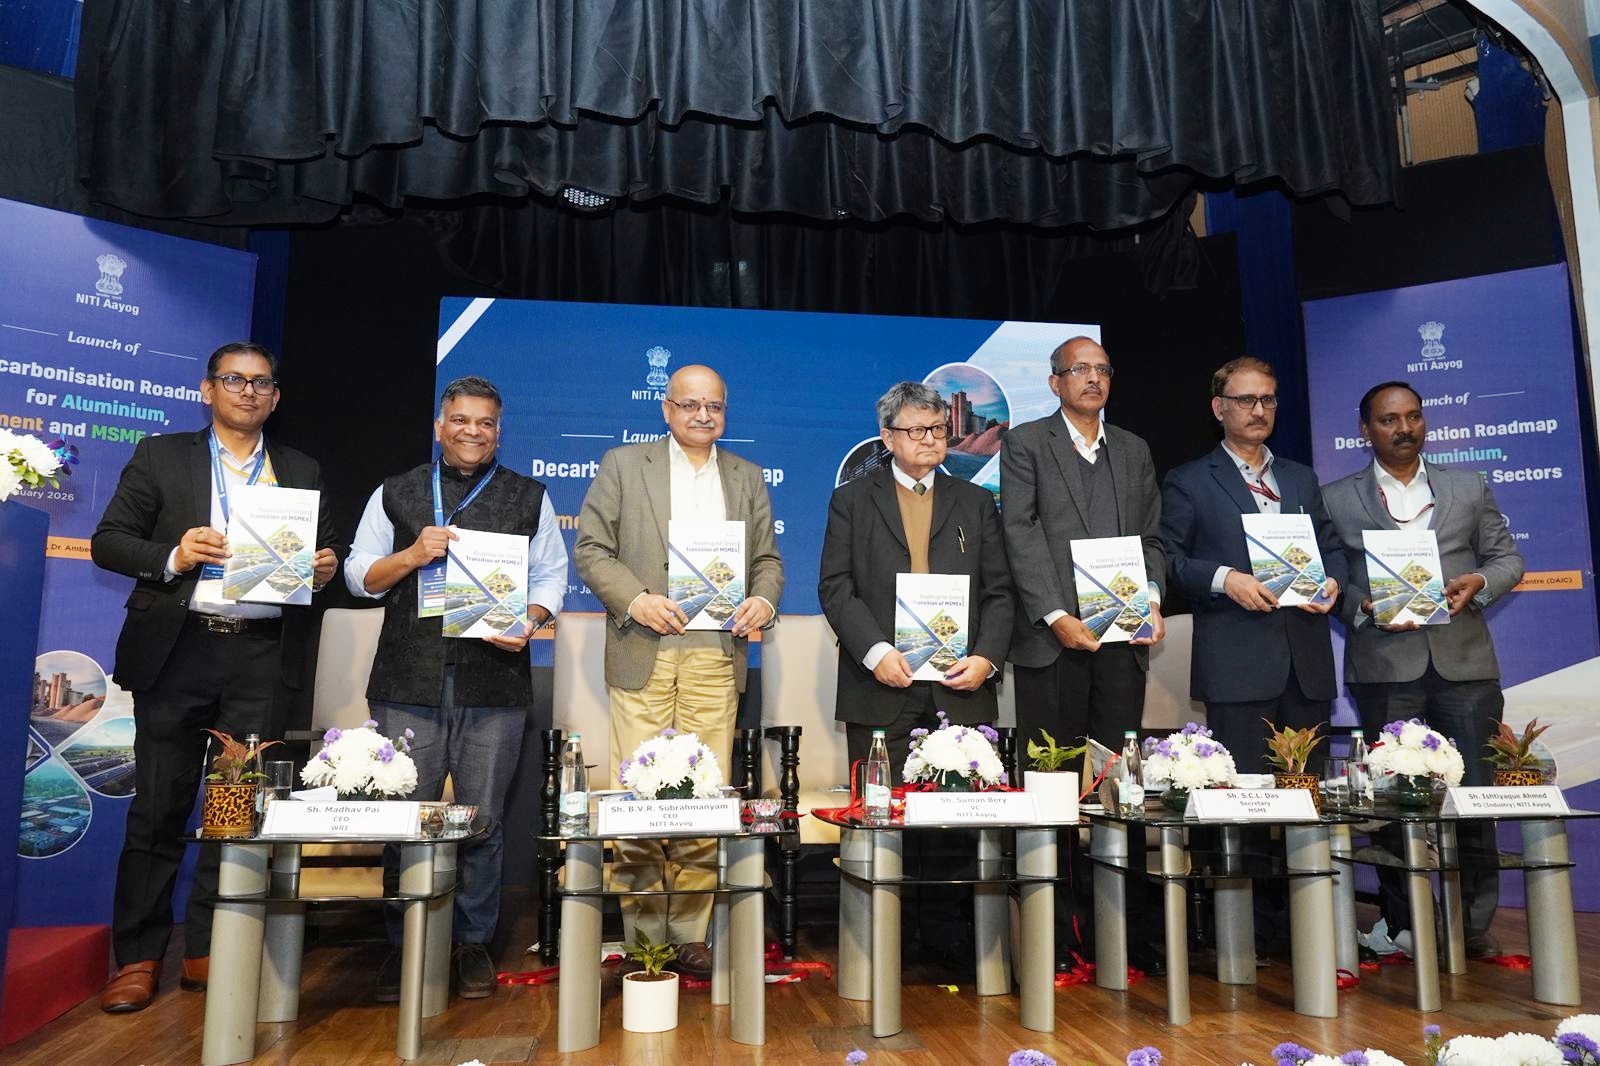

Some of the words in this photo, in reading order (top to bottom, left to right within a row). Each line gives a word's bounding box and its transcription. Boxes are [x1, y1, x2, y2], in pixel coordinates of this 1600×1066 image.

[76, 293, 100, 306] NITI
[103, 300, 140, 315] Aayog
[68, 331, 122, 350] Launch
[124, 342, 141, 356] of
[1407, 362, 1428, 372] NITI
[1430, 358, 1462, 372] Aayog
[0, 359, 134, 392] carbonisation
[140, 380, 202, 403] Roadm
[632, 390, 650, 400] NITI
[1422, 394, 1452, 407] unch
[1456, 392, 1470, 406] of
[26, 388, 56, 407] for
[61, 394, 170, 426] Aluminium,
[49, 420, 86, 438] and
[1475, 418, 1558, 438] Roadmap
[1423, 446, 1508, 465] luminium,
[1492, 466, 1562, 484] Sectors
[48, 491, 74, 502] 2026
[65, 544, 90, 553] Ambe
[1547, 576, 1573, 585] (DAIC)
[658, 803, 728, 812] Subrahmanyam
